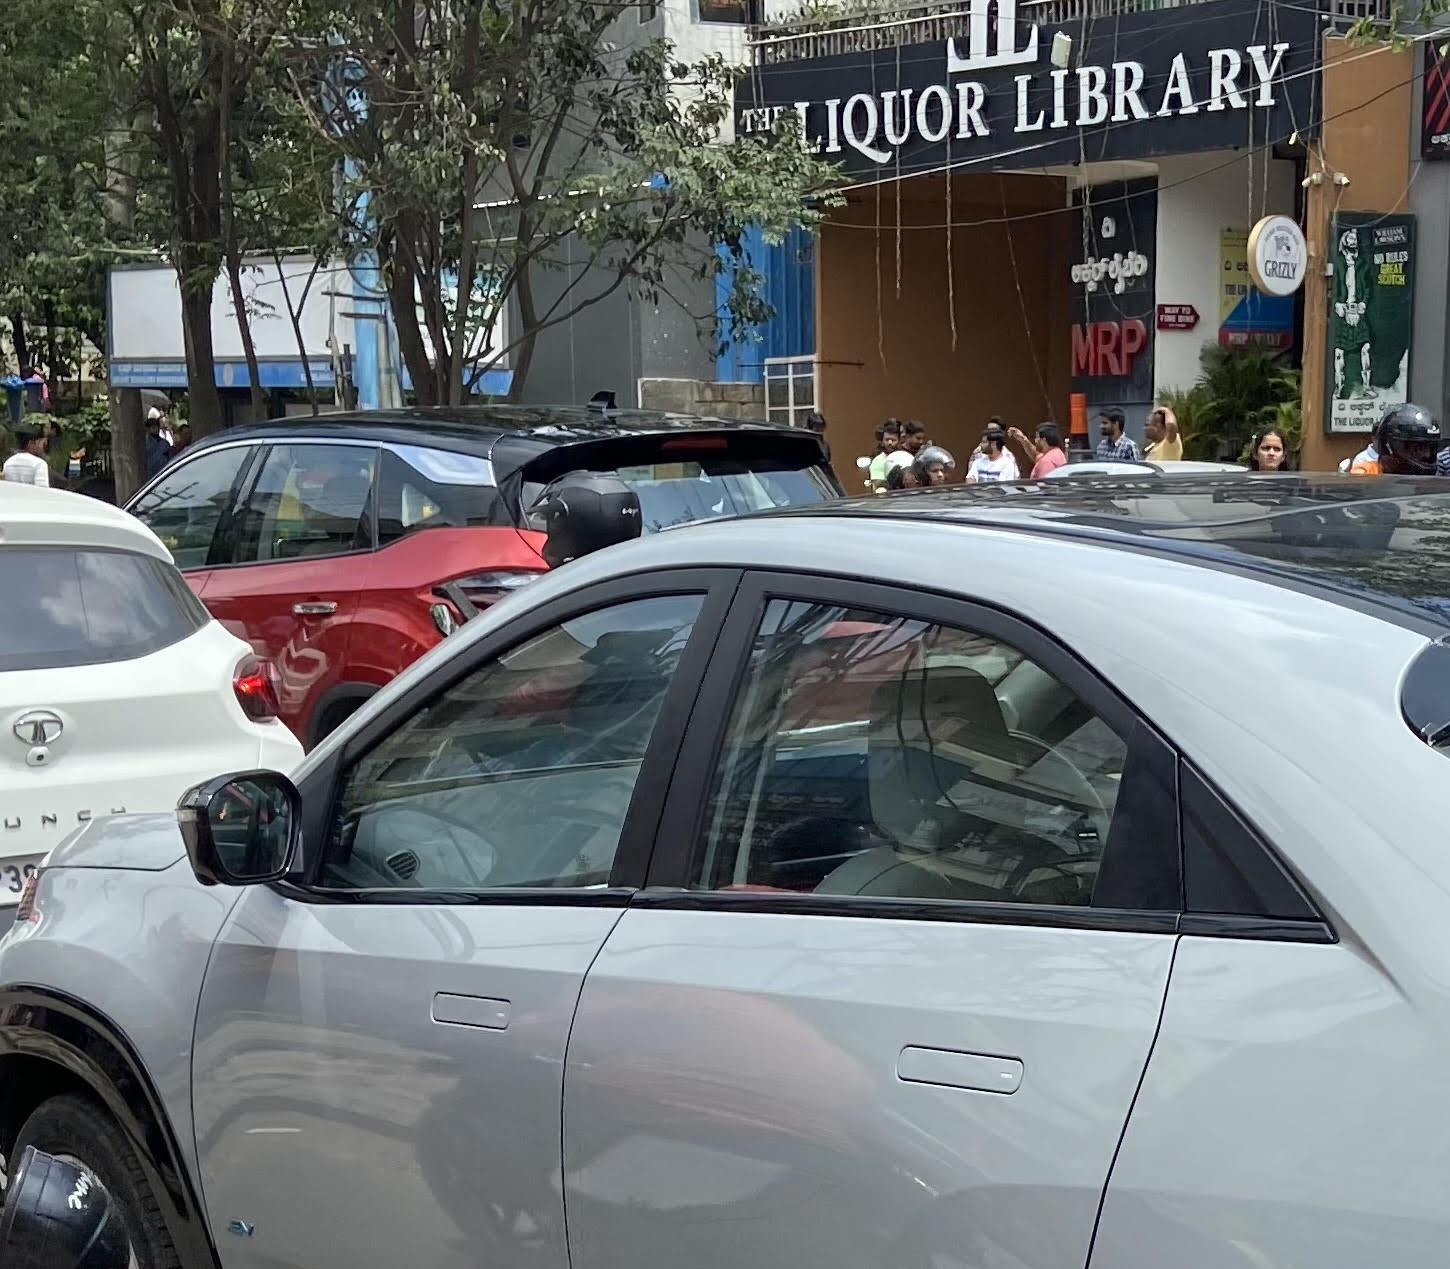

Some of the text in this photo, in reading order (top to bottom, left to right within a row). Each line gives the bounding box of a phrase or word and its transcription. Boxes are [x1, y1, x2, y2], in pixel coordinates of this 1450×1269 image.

[794, 82, 991, 164] LIQUOR
[1013, 43, 1290, 133] LIBRARY
[1071, 320, 1147, 378] MRP
